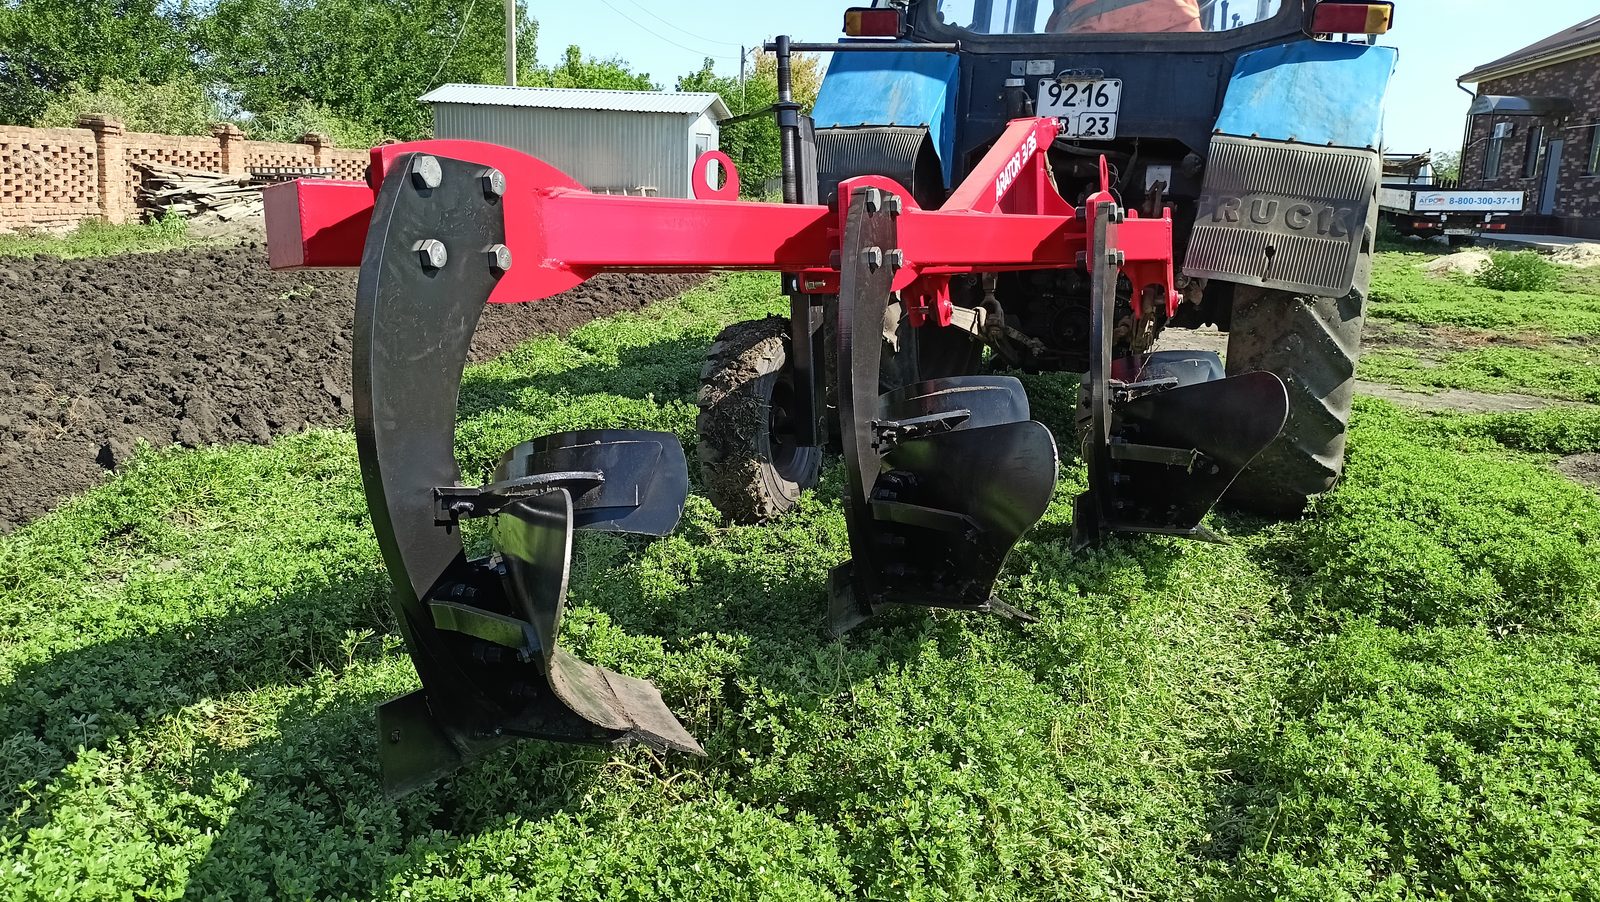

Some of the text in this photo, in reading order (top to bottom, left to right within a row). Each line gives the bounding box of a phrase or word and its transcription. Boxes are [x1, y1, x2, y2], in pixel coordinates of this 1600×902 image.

[1047, 83, 1110, 108] 9216
[1085, 117, 1110, 136] 23
[995, 151, 1021, 202] ARATOR
[1449, 197, 1520, 205] 8-800-300-37-11
